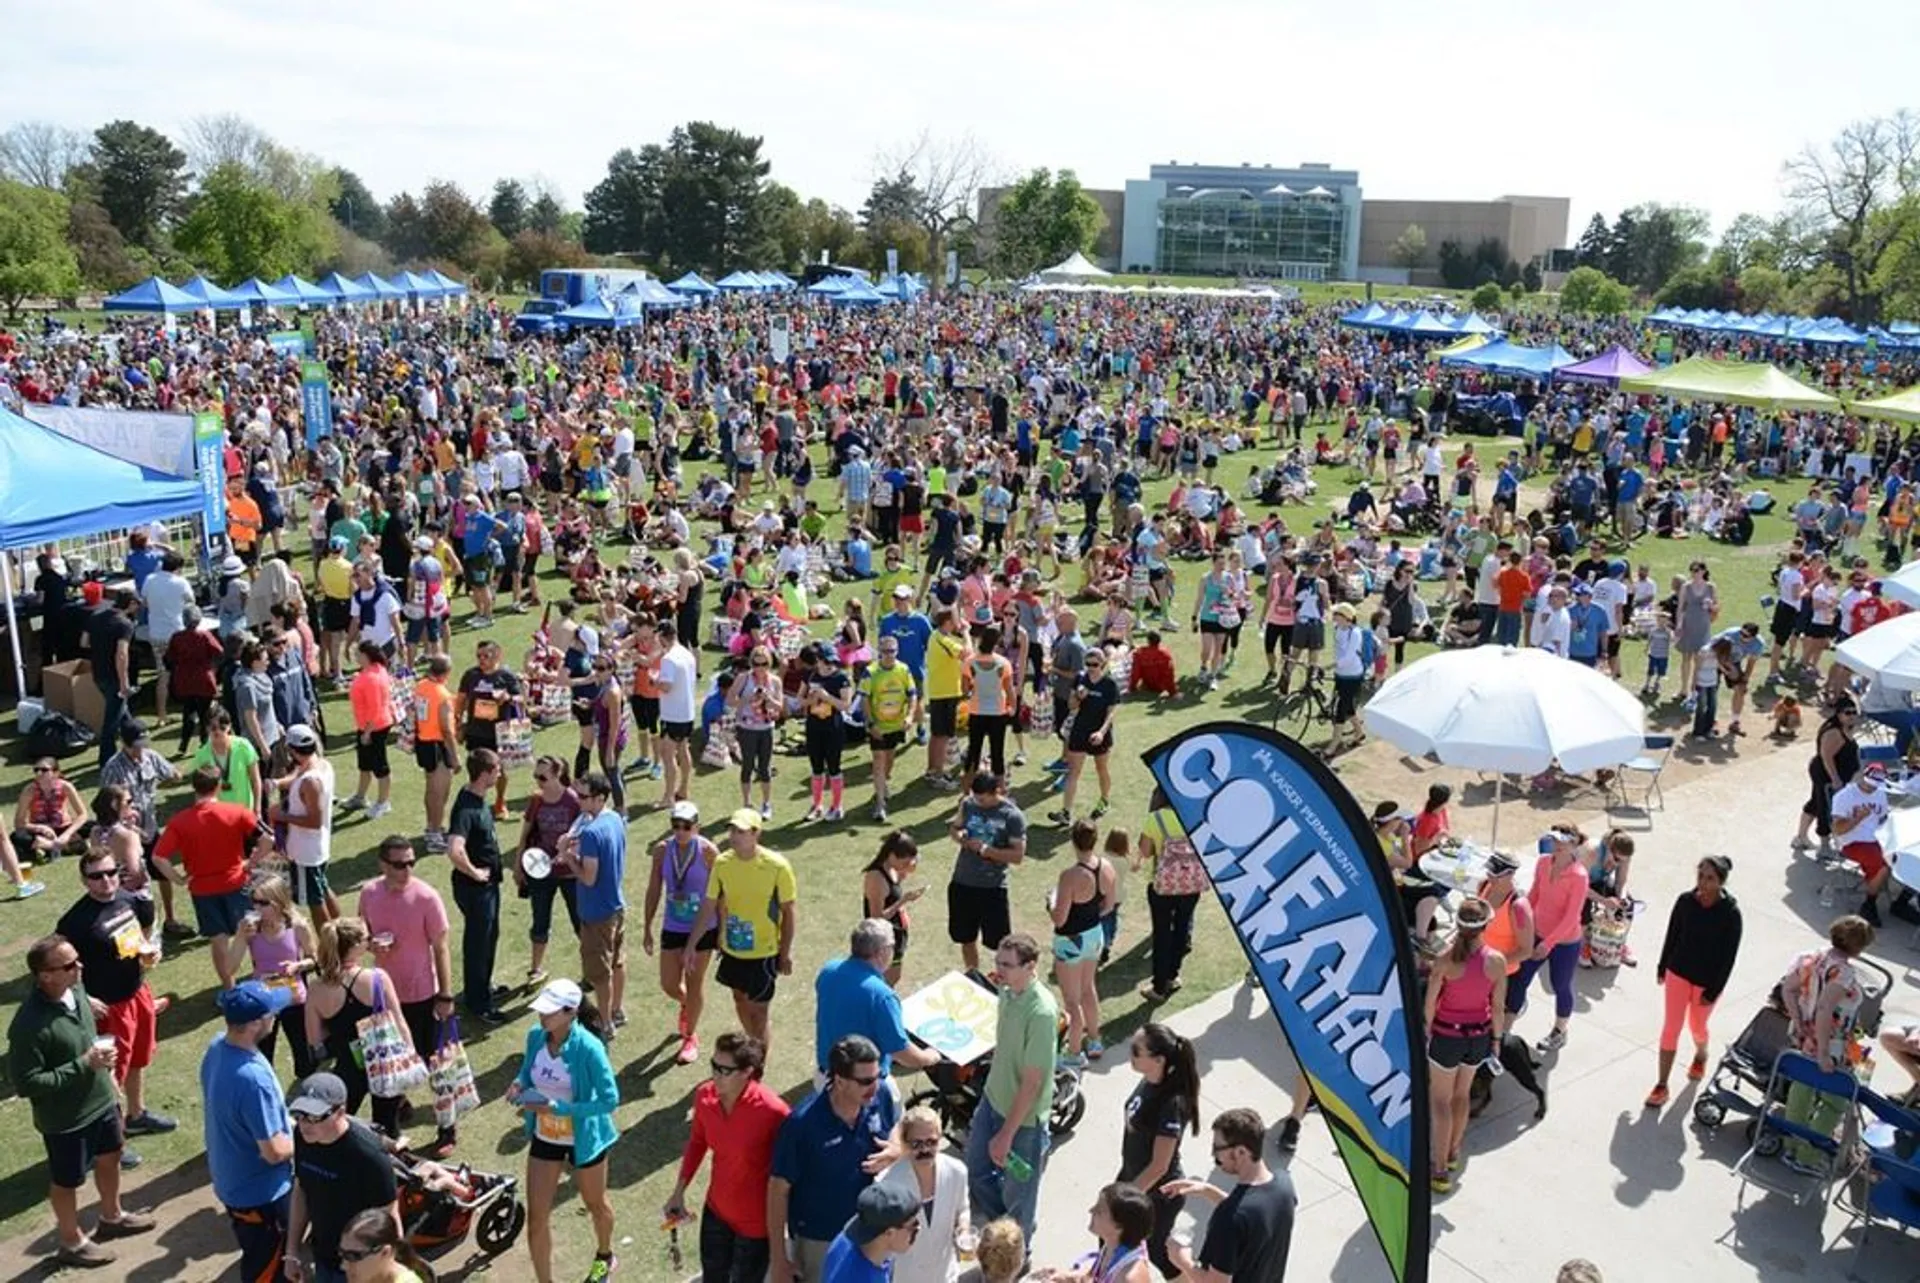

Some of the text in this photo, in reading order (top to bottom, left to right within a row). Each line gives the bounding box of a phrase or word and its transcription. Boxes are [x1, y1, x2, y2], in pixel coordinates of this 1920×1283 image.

[1167, 732, 1403, 1045] COLFAX
[1189, 820, 1412, 1129] MARATHON
[1270, 770, 1361, 885] KAISER PERMANENTE
